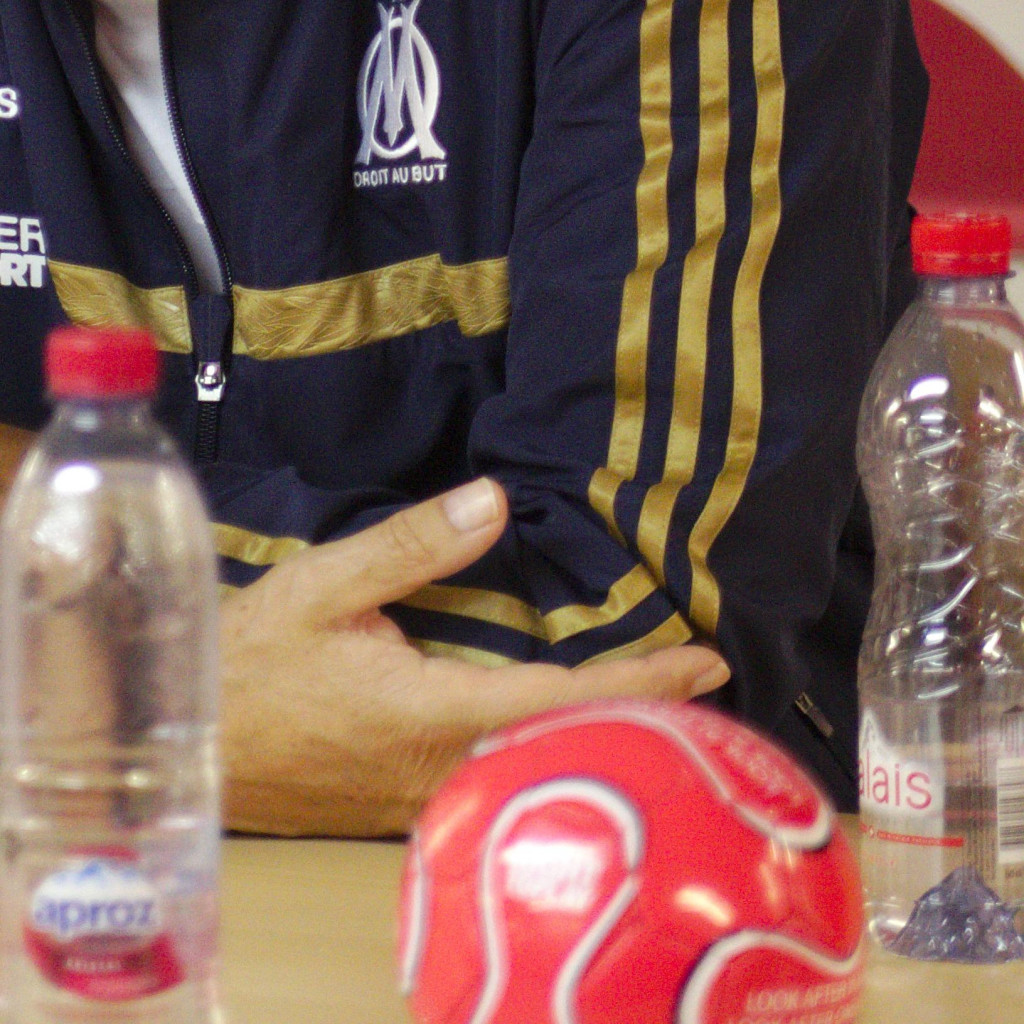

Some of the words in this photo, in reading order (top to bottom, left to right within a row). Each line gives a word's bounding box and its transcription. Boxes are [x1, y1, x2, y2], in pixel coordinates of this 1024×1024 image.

[354, 168, 388, 188] DROIT
[392, 167, 409, 184] AU
[412, 164, 447, 182] BUT
